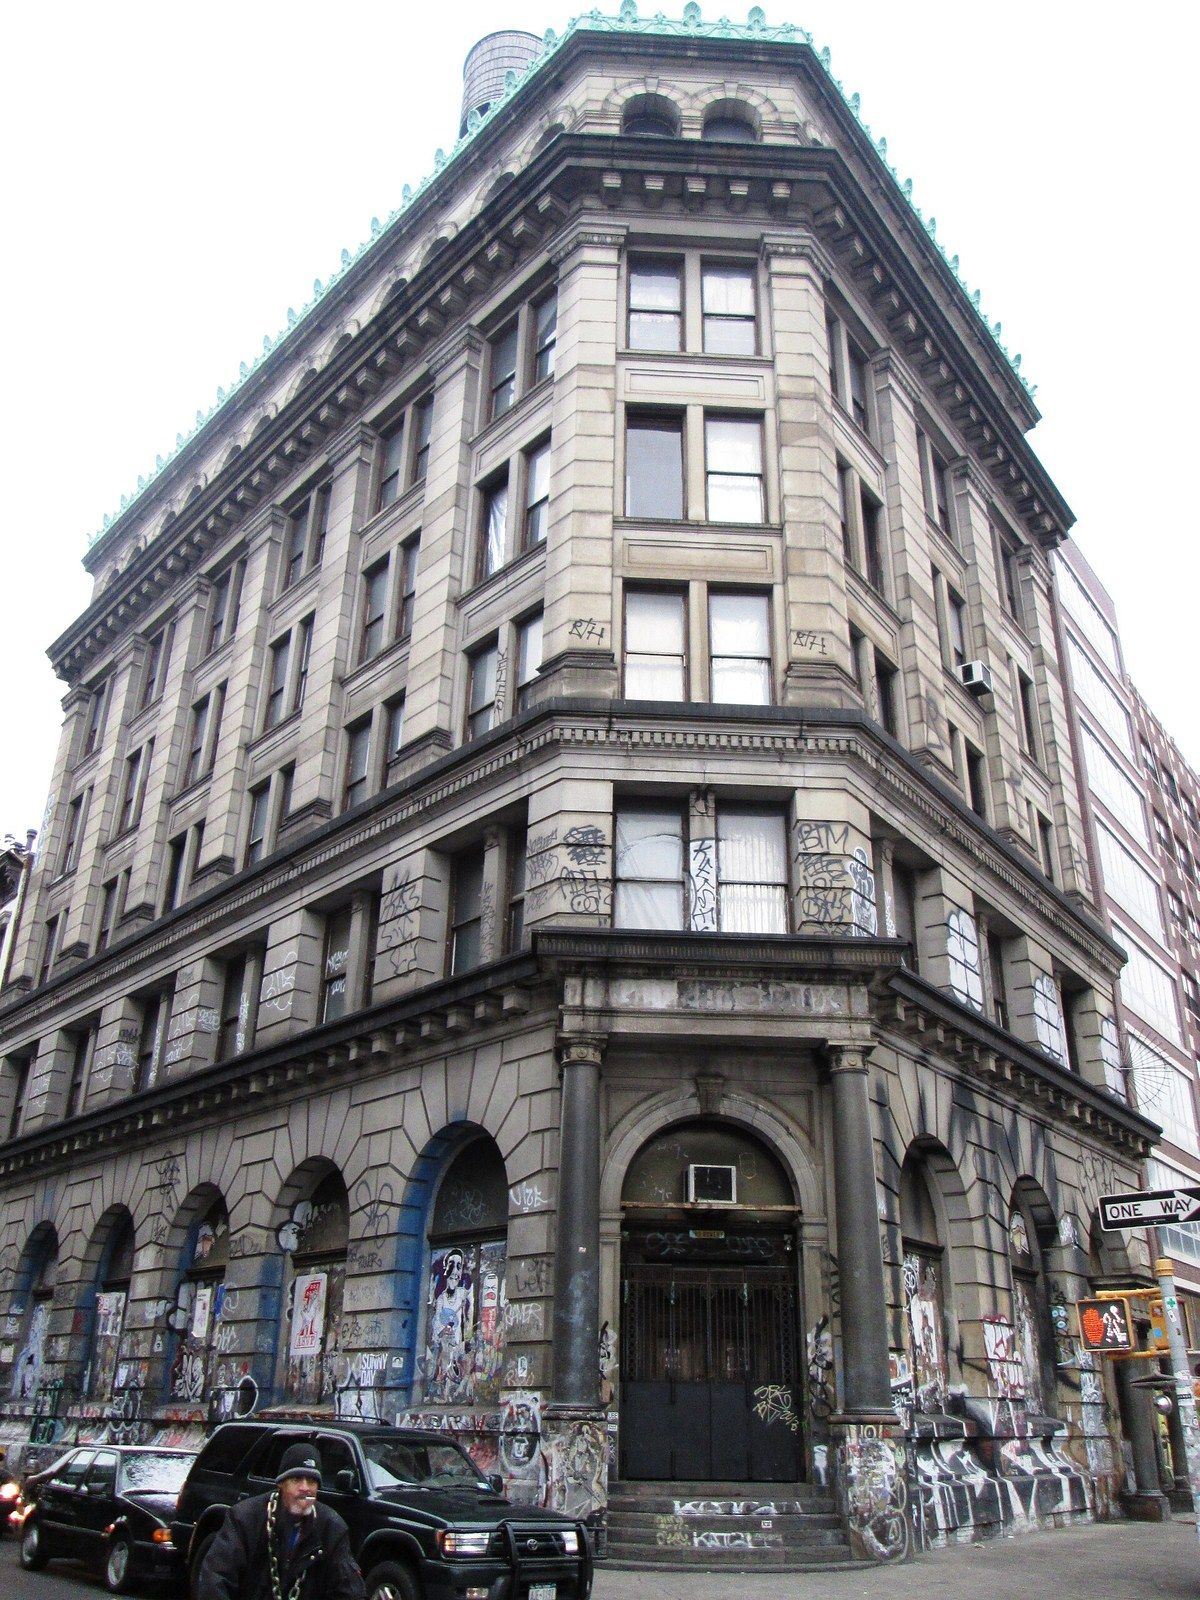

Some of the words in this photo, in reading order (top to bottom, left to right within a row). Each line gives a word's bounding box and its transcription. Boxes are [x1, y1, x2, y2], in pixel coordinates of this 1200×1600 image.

[1109, 1203, 1143, 1219] ONE
[1160, 1198, 1192, 1214] WAY
[361, 1353, 388, 1370] SUNNY
[360, 1370, 376, 1387] DAY
